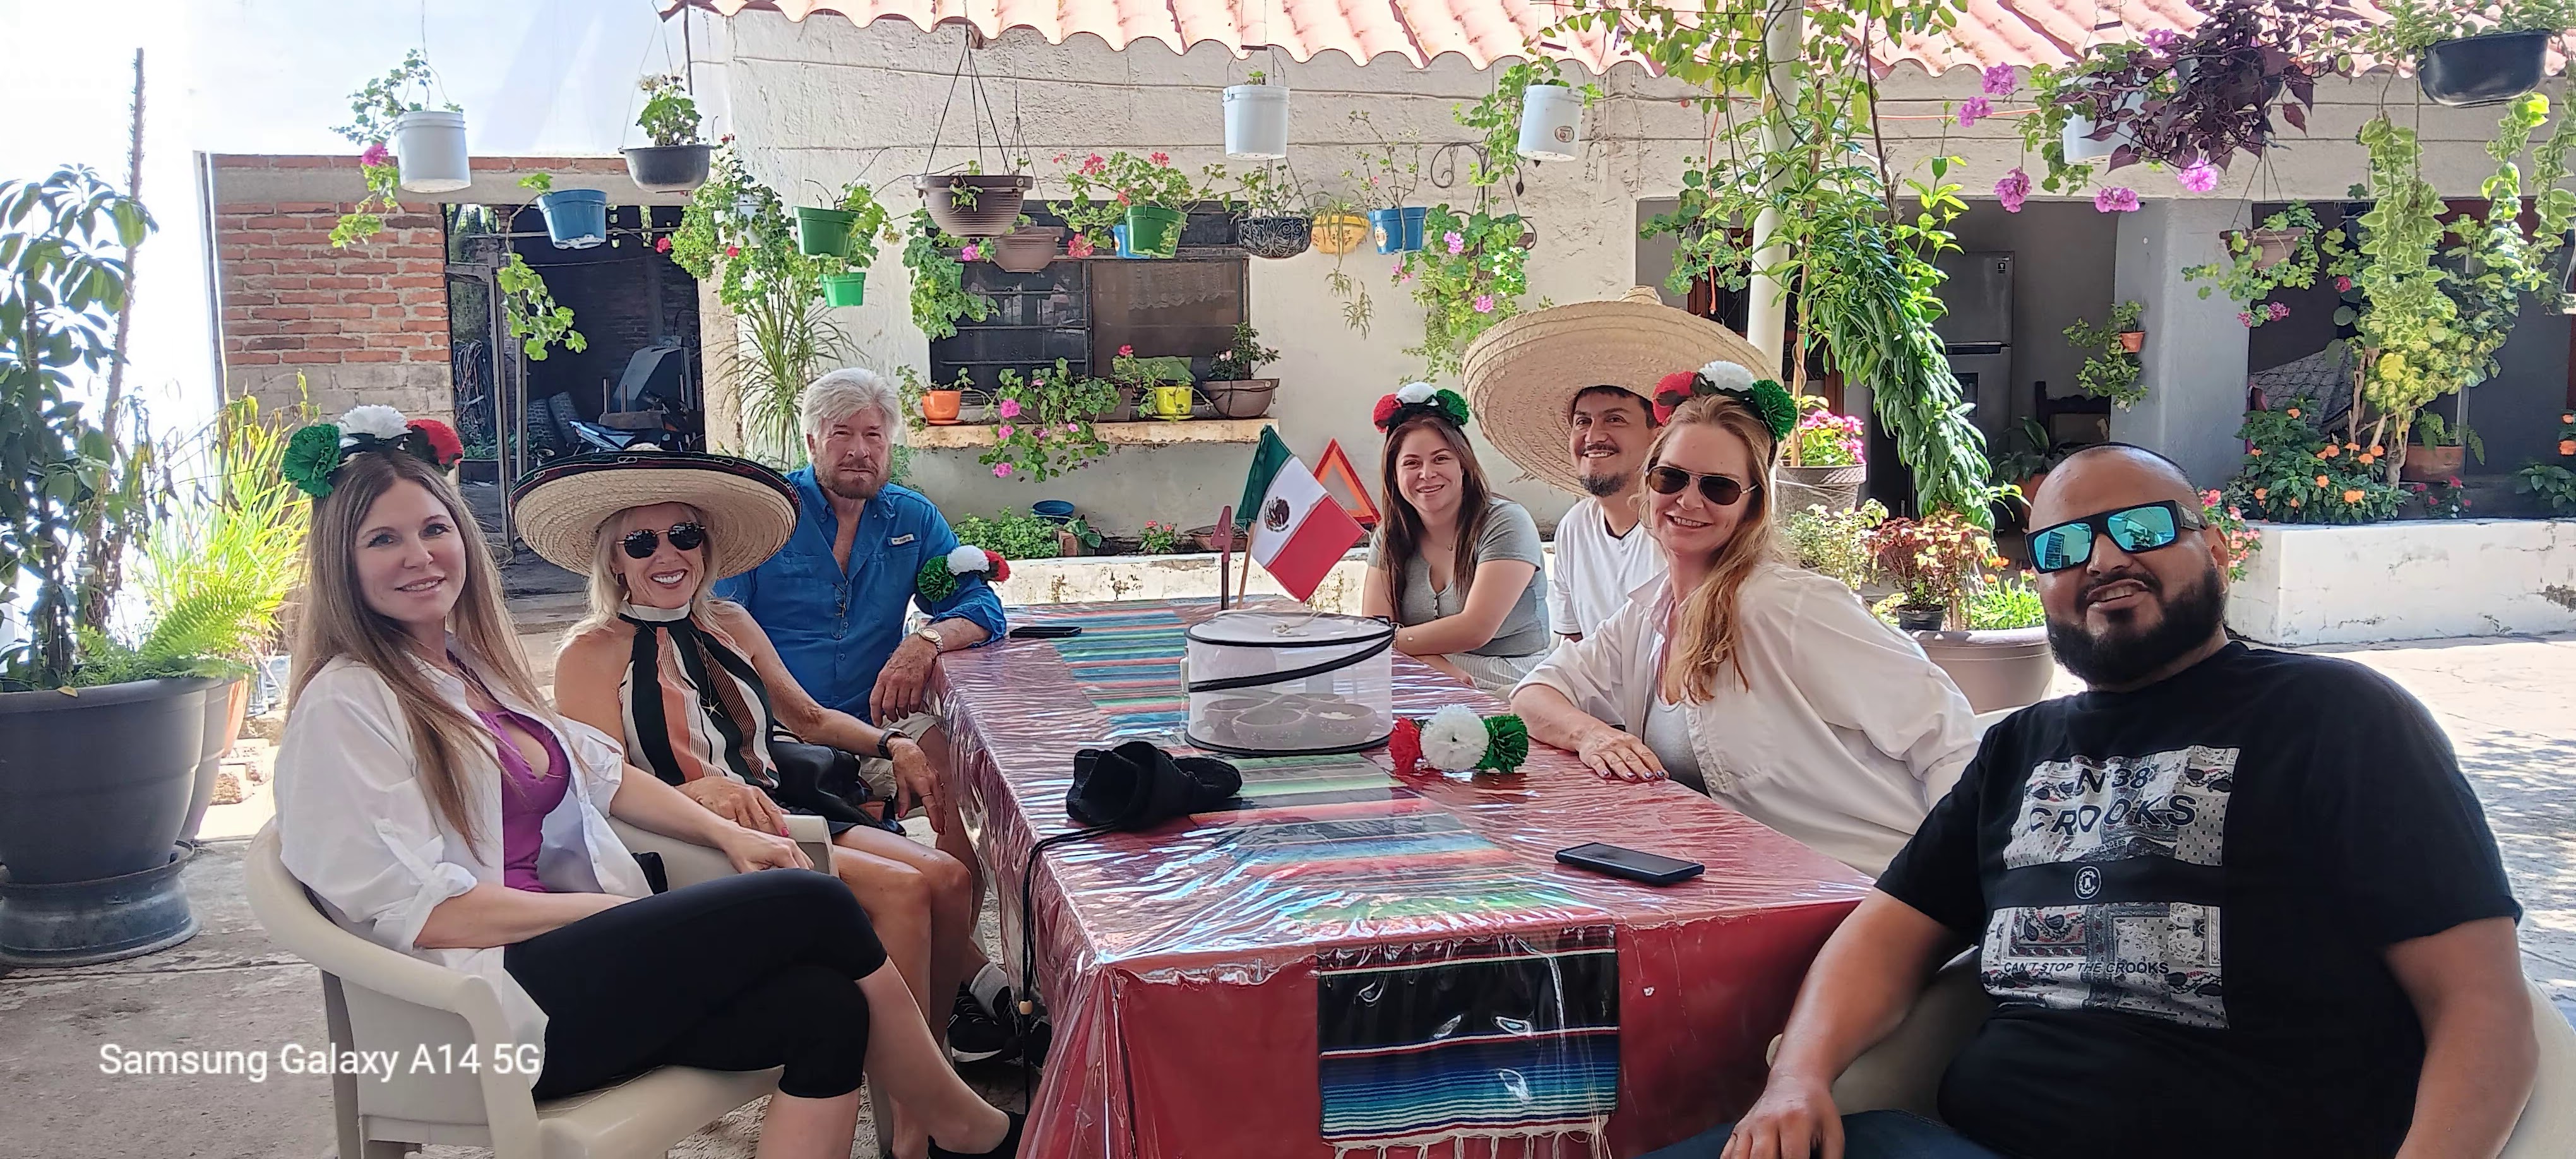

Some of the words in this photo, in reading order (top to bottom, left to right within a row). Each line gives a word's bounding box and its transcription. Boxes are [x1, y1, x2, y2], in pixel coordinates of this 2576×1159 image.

[2030, 794, 2197, 836] CROOKS
[2039, 963, 2074, 972] STOP
[2078, 963, 2102, 973] THE
[2106, 962, 2169, 973] CROOKS
